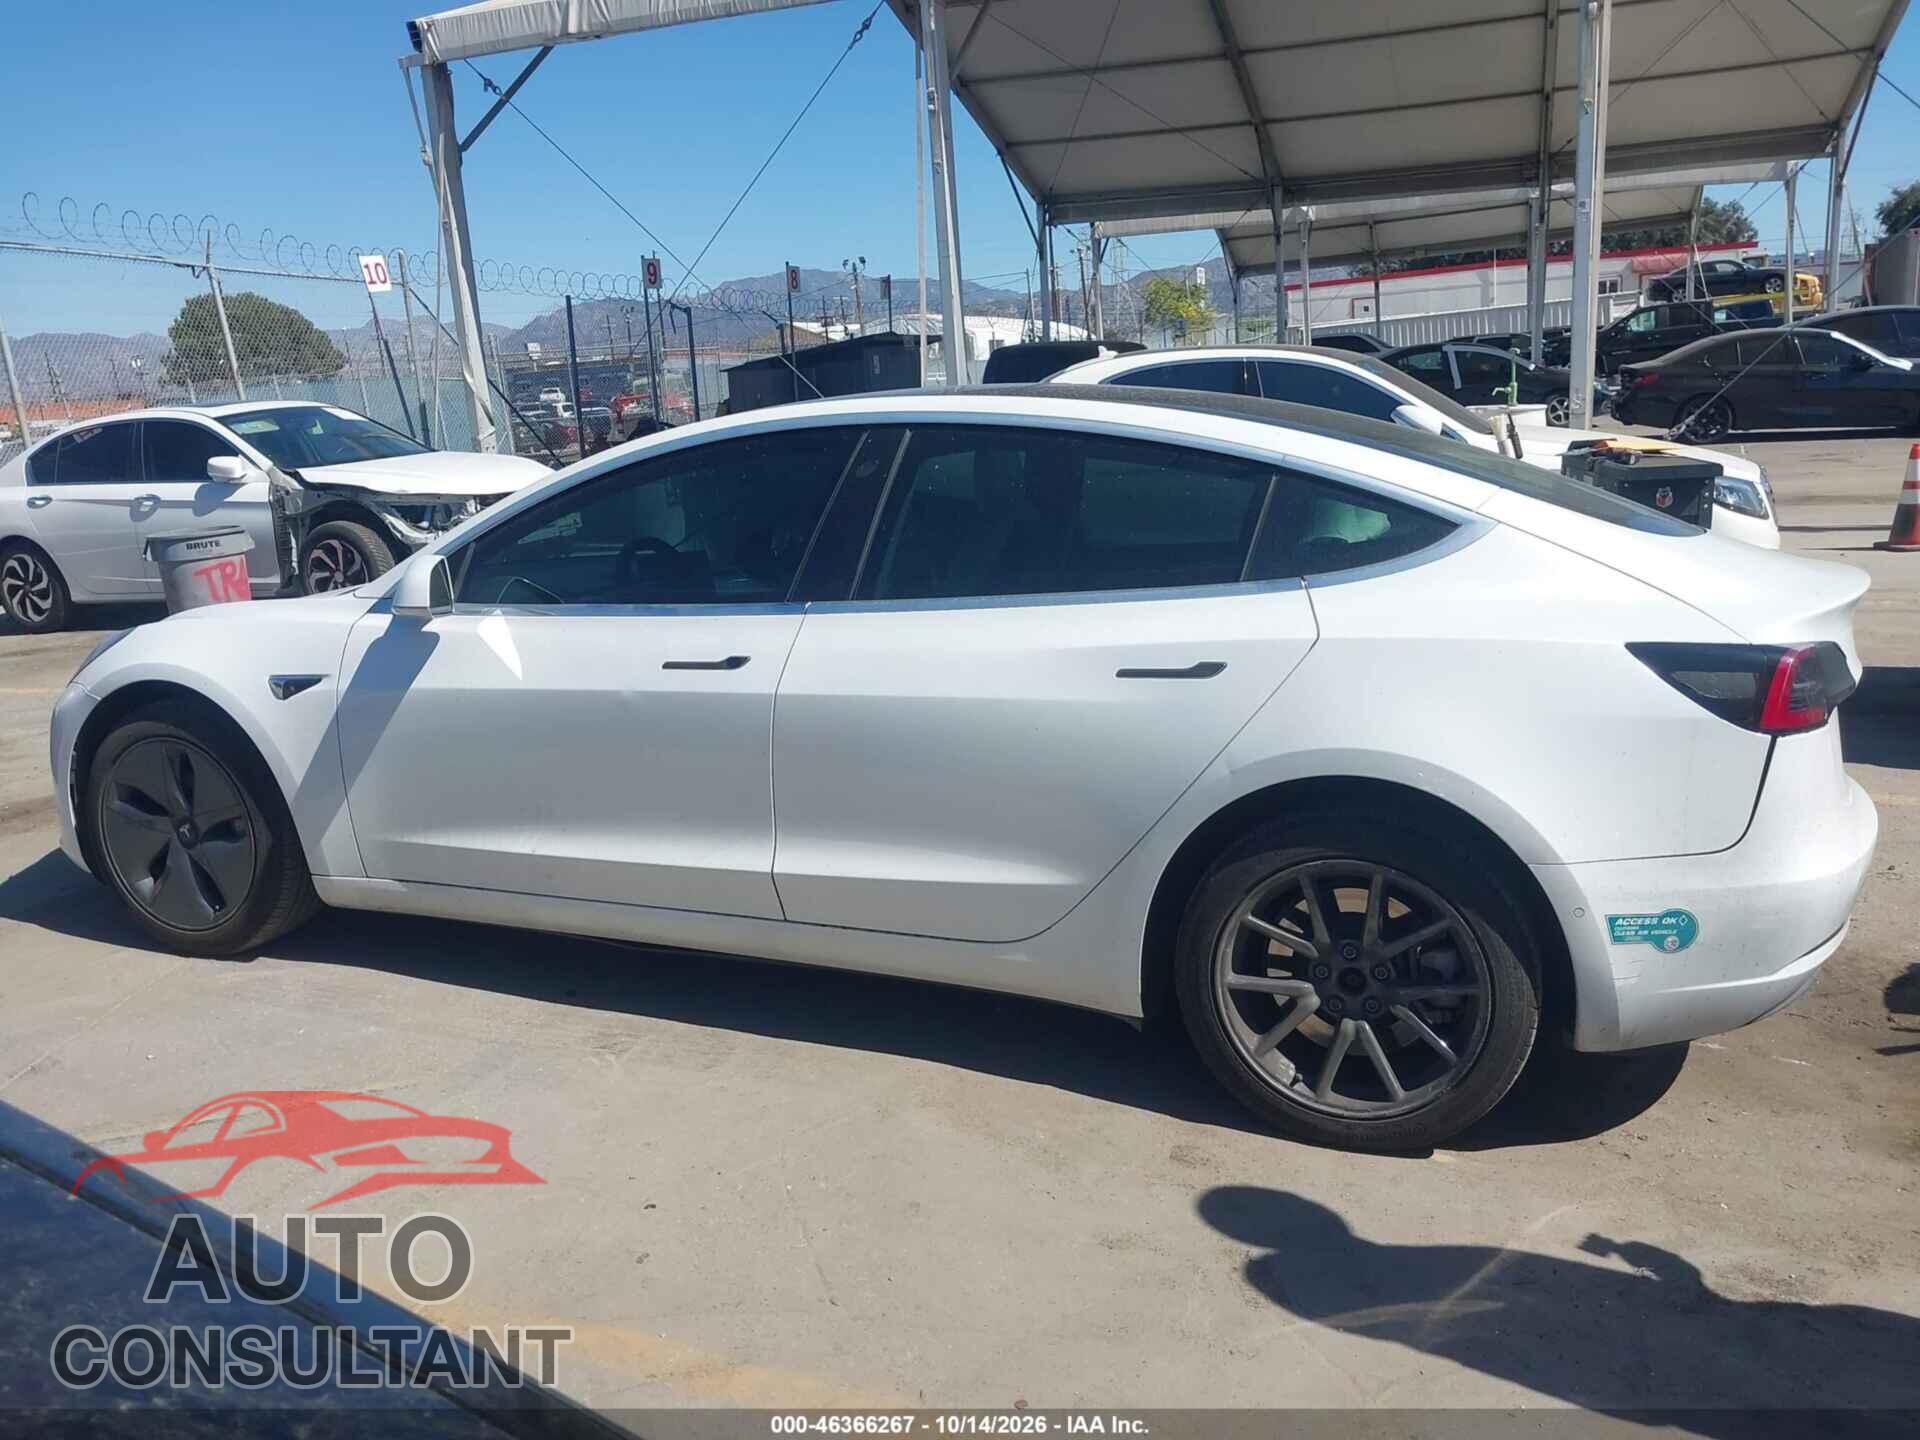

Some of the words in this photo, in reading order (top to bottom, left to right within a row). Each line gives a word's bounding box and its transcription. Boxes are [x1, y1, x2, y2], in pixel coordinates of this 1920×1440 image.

[363, 262, 388, 285] 10
[647, 262, 657, 285] 9
[789, 269, 798, 289] 8
[186, 539, 221, 551] BRUTE
[1615, 917, 1659, 926] ACCESS
[1662, 916, 1679, 925] OK
